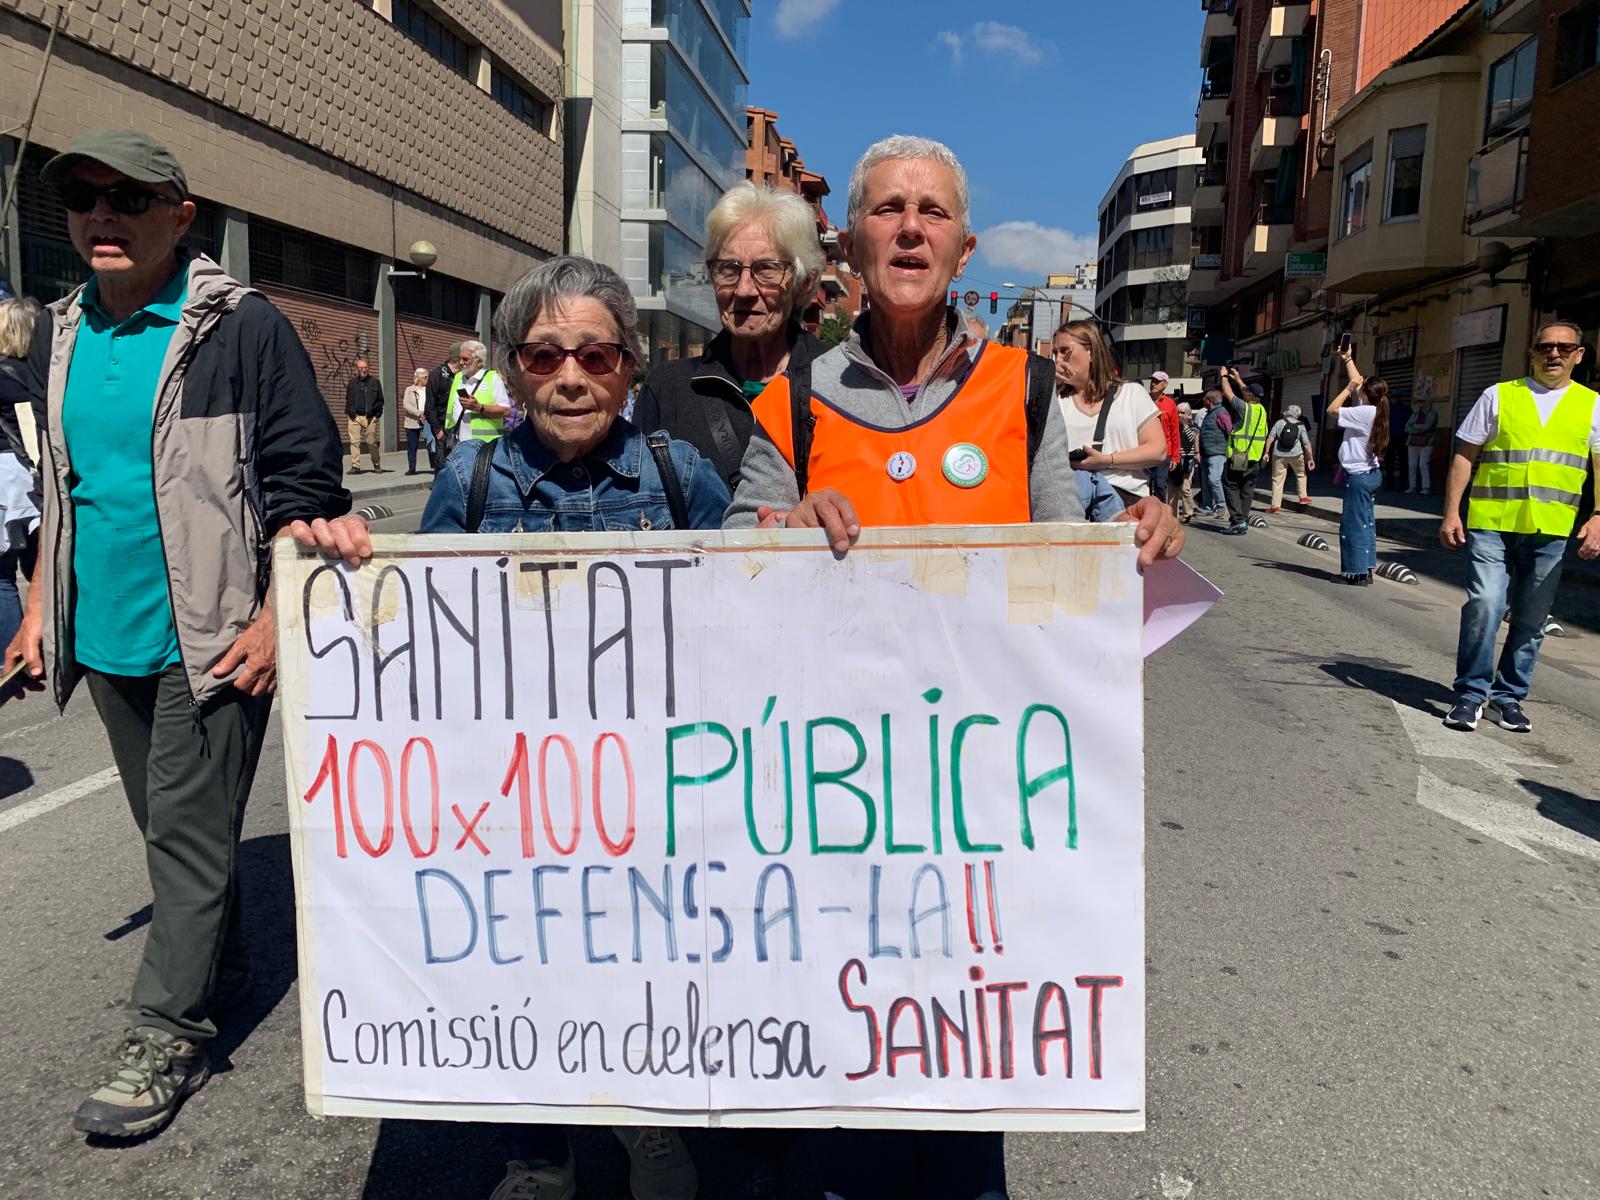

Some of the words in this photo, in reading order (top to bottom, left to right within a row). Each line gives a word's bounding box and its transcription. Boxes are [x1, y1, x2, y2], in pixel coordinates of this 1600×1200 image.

[323, 989, 538, 1071] Comissió
[557, 1020, 614, 1074] en
[622, 981, 826, 1079] defensa
